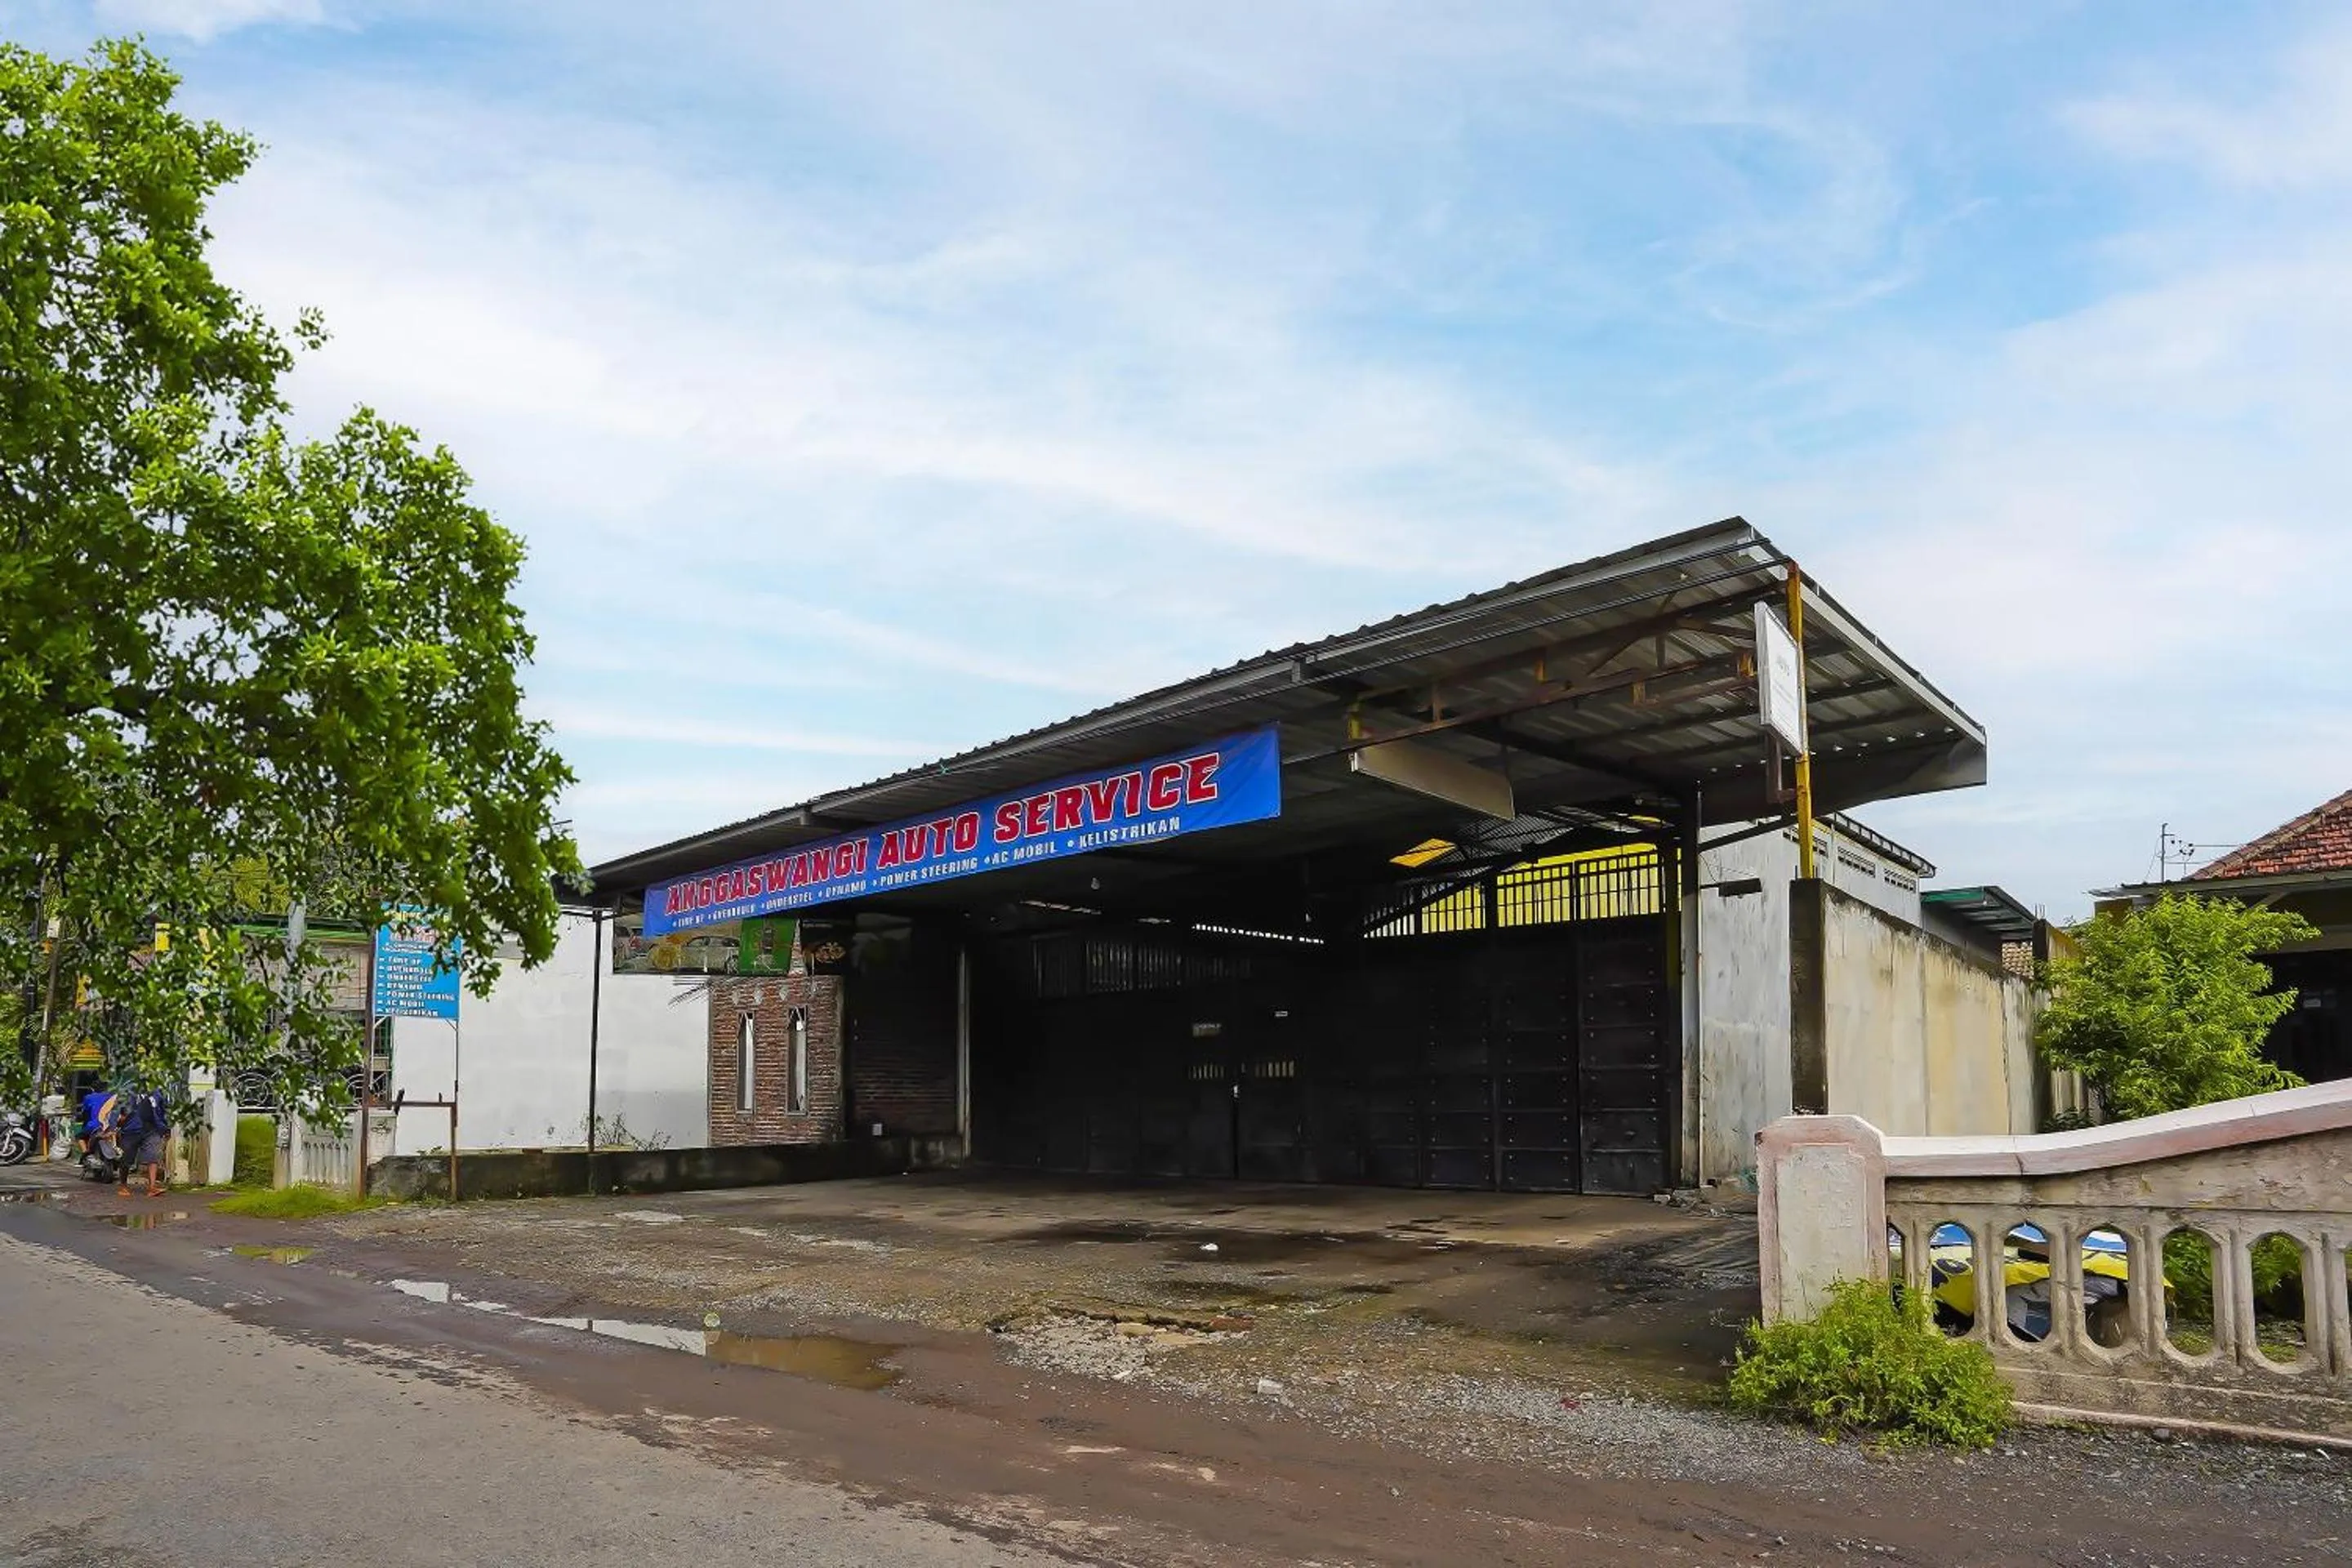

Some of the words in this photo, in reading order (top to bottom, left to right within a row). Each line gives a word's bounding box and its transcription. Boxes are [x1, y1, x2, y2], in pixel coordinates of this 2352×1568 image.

[665, 838, 869, 915] ANGGASWANGI
[877, 812, 979, 869] AUTO
[993, 752, 1220, 844] SERVICE
[825, 879, 867, 898] DYNAMO
[880, 869, 917, 887] POWER
[920, 858, 978, 879] STEERING
[992, 852, 1009, 866] AC
[1013, 842, 1058, 861] MOBIL
[1079, 816, 1181, 849] KELISTRIKAN
